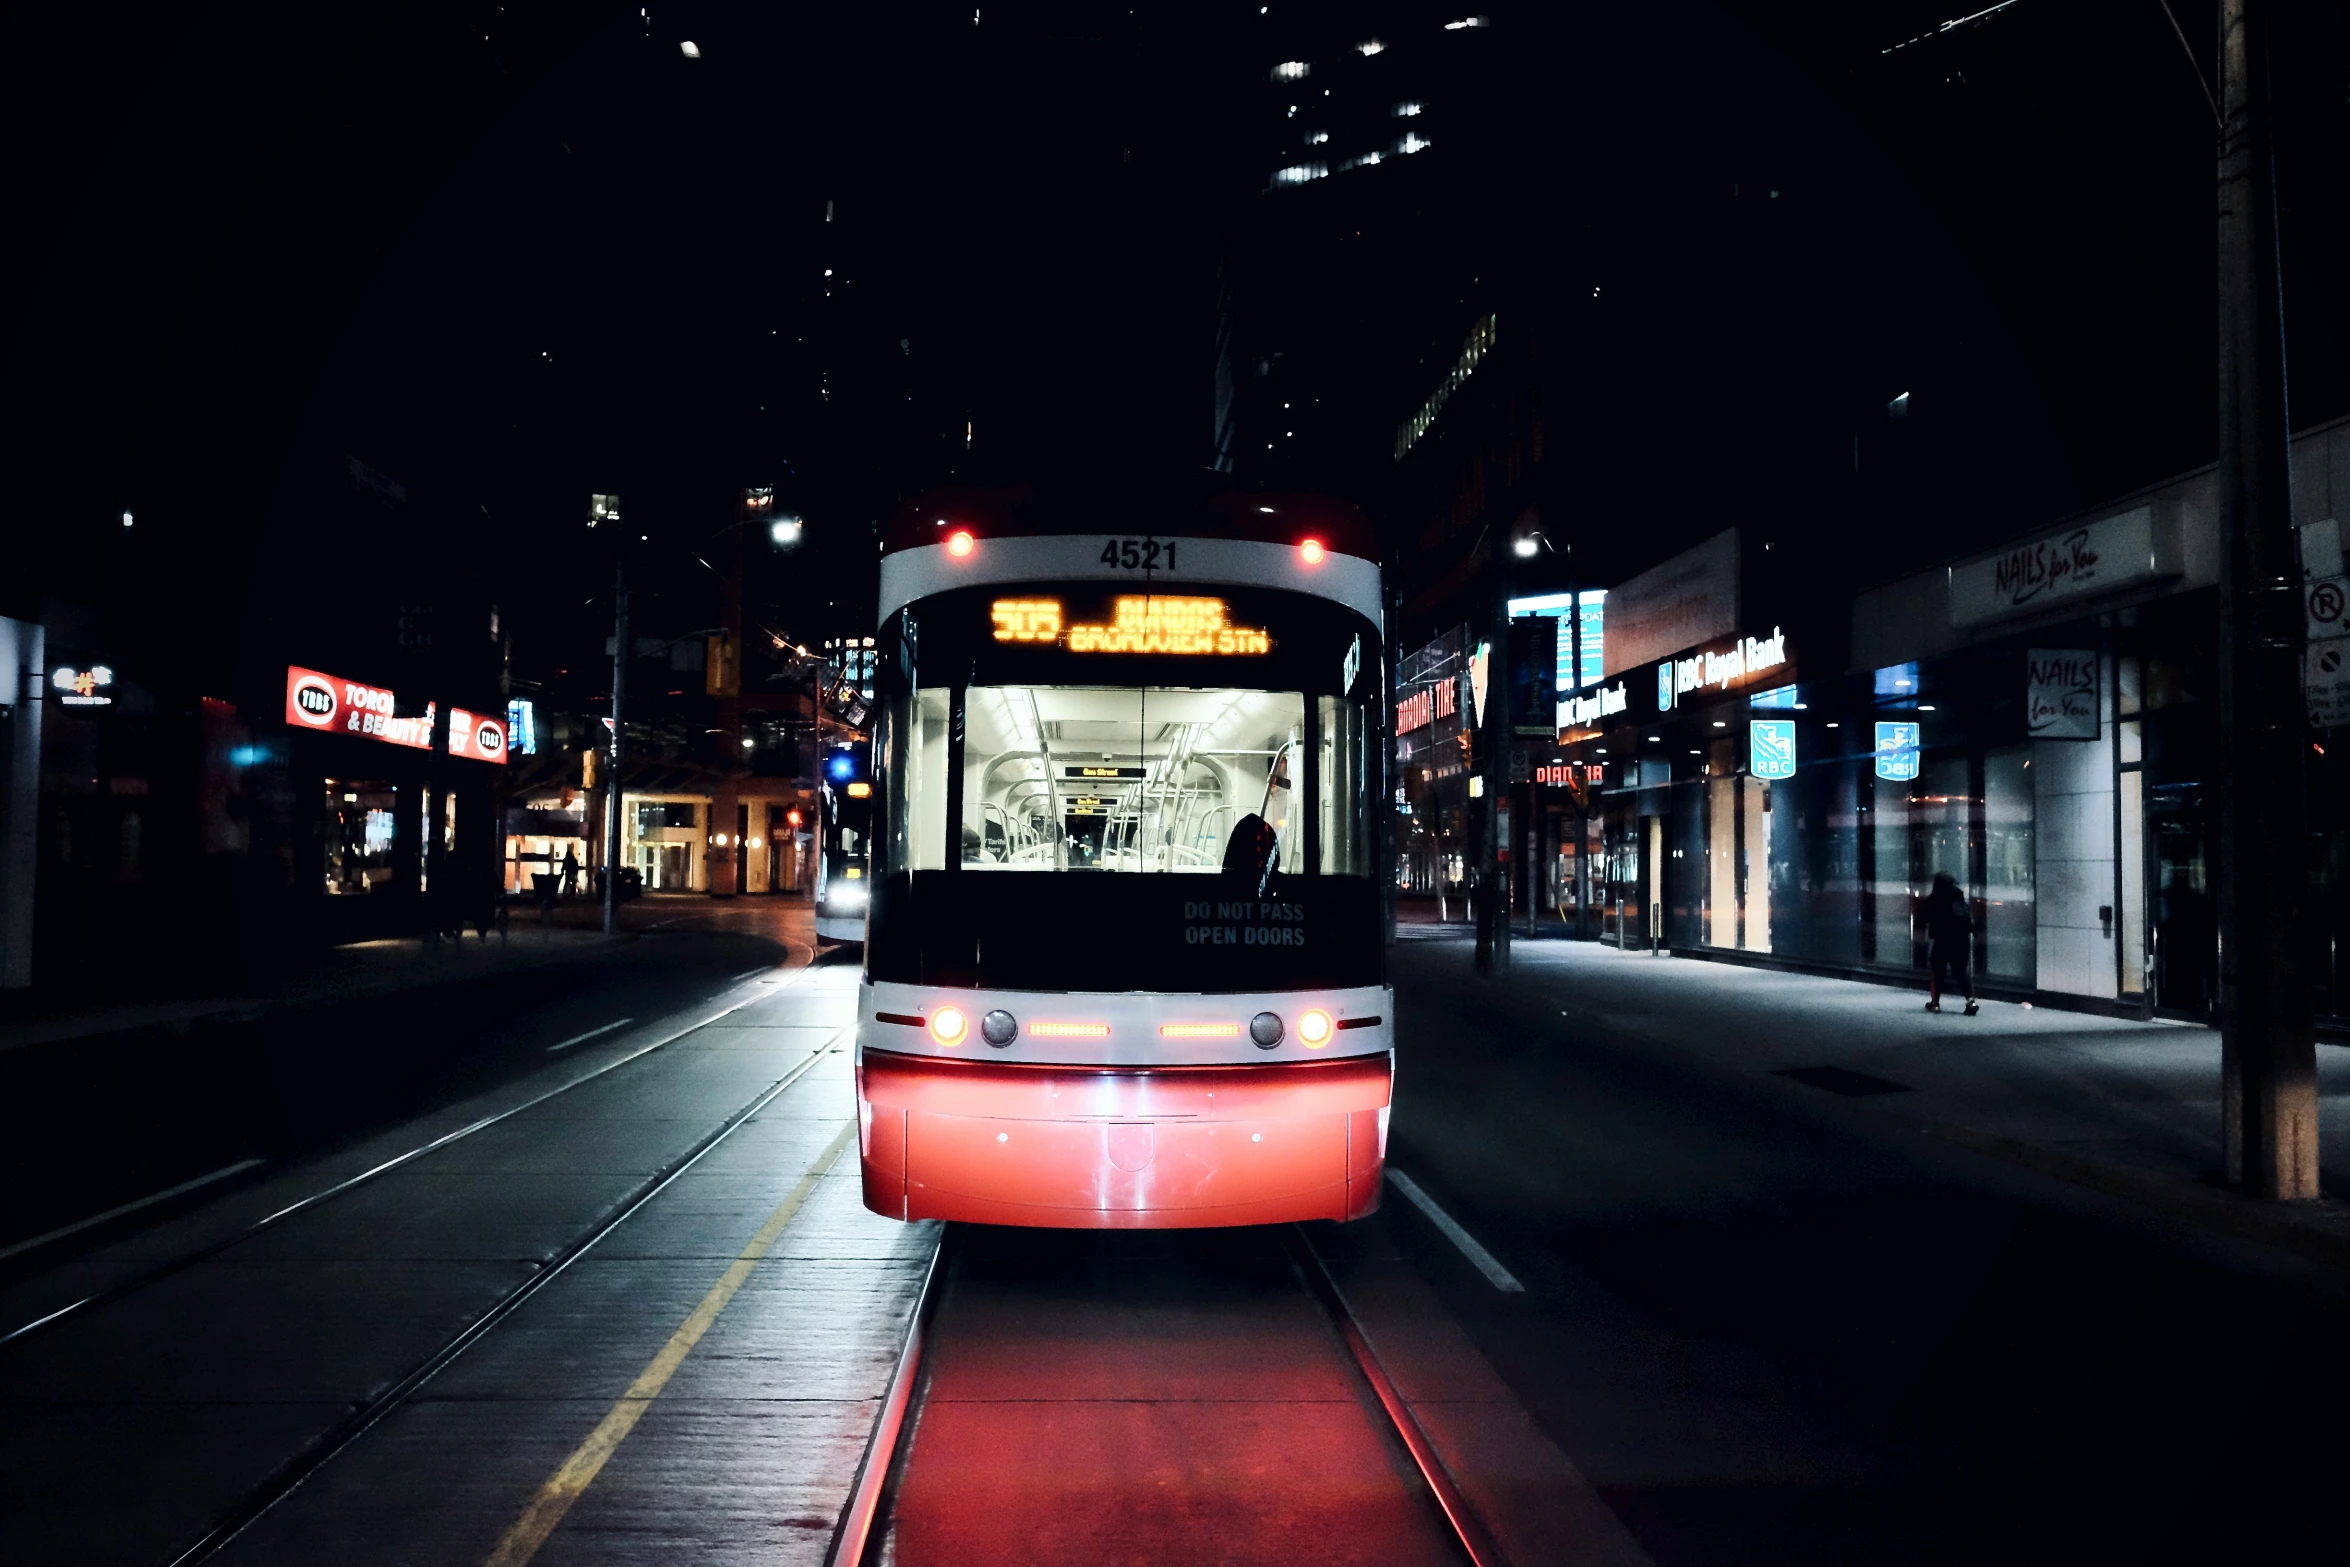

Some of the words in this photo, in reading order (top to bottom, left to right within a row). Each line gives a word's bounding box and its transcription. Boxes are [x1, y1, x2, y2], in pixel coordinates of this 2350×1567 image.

[1100, 539, 1176, 570] 4521
[1996, 542, 2045, 596] NAILS
[2049, 549, 2070, 589] for
[2071, 538, 2098, 574] You
[1069, 627, 1212, 654] BROADVIEW
[1217, 629, 1269, 654] STN
[1677, 654, 1704, 694] RBC
[1705, 639, 1743, 690] Royal
[1745, 626, 1786, 672] Bank
[2028, 660, 2094, 688] NAILS
[302, 689, 330, 712] TBBS
[1434, 676, 1456, 719] TIRE
[1576, 688, 1601, 728] Royal
[1601, 680, 1627, 716] Bank
[2032, 696, 2056, 721] for
[2062, 698, 2090, 716] You
[347, 711, 360, 731] &
[363, 712, 420, 744] BEAUTY
[481, 731, 499, 748] TBBS
[1757, 761, 1790, 773] RBC
[1184, 901, 1211, 920] DO
[1217, 901, 1254, 920] NOT
[1260, 902, 1304, 921] PASS
[1185, 926, 1237, 945] OPEN
[1244, 926, 1305, 946] DOORS
